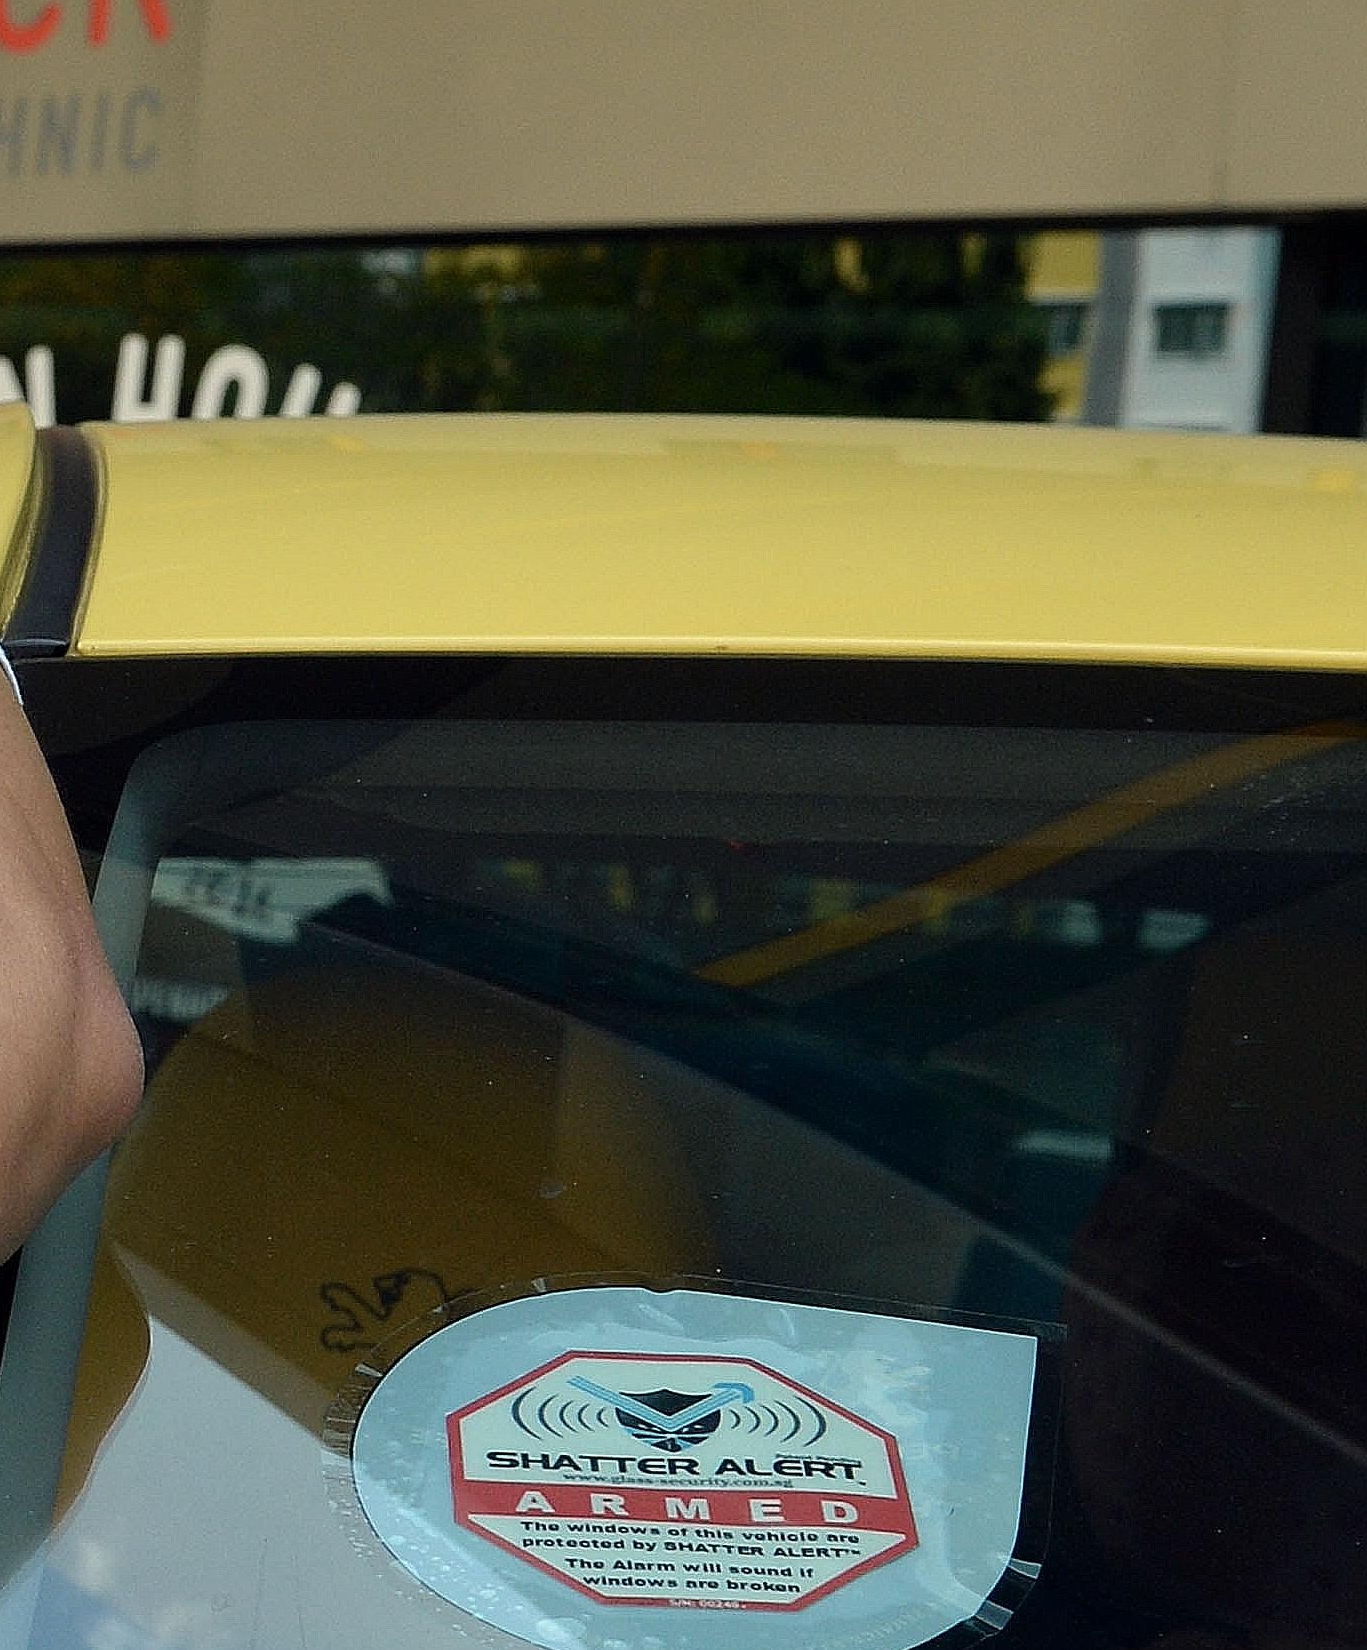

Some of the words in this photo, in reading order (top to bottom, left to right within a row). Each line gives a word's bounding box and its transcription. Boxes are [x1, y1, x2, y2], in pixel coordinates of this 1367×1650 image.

[486, 1451, 700, 1477] SHATTER
[514, 1490, 861, 1524] ARMED
[520, 1520, 560, 1532] The
[567, 1522, 661, 1536] windows
[695, 1528, 734, 1540] this
[521, 1537, 625, 1549] protected
[633, 1539, 657, 1552] by
[664, 1541, 764, 1556] SHATTER
[564, 1558, 605, 1569] The
[612, 1560, 676, 1572] Alarm
[682, 1562, 722, 1573] will
[728, 1564, 793, 1578] sound
[582, 1575, 678, 1588] windows
[726, 1579, 801, 1593] broken
